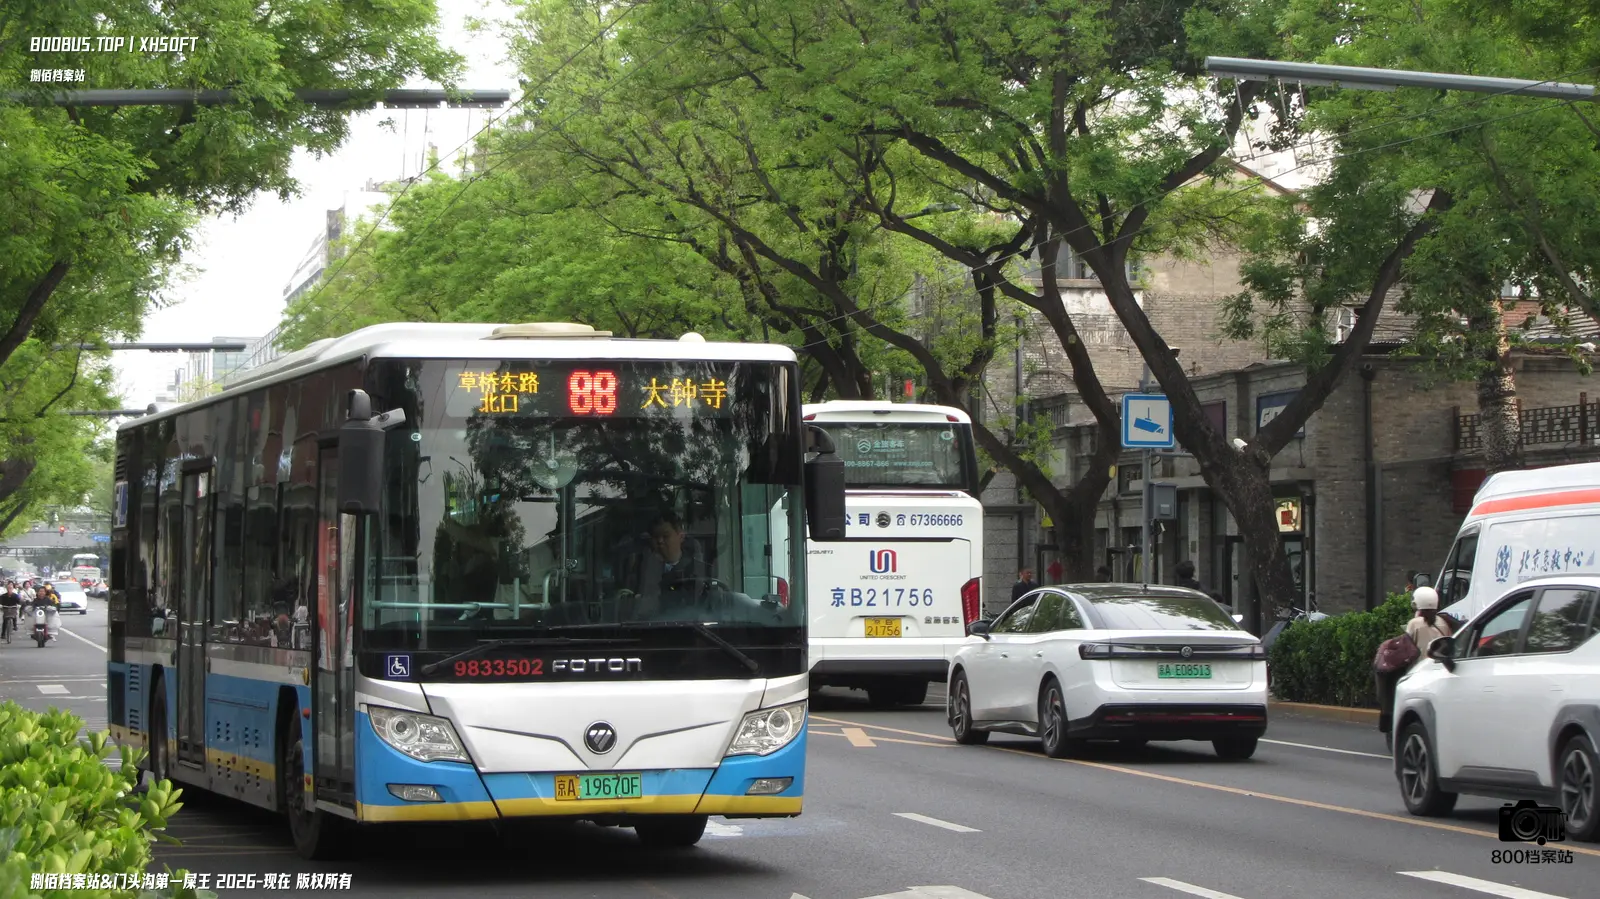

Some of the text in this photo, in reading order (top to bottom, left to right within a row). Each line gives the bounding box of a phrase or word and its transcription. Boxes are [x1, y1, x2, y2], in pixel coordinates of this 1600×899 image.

[458, 372, 540, 393] 草桥东路
[569, 371, 617, 413] 88
[479, 394, 519, 413] 北口
[641, 378, 729, 409] 大钟寺
[910, 514, 963, 526] 67366666
[1518, 547, 1583, 574] 北京急救中心
[831, 587, 933, 608] 京B21756
[867, 626, 900, 636] 21756
[455, 659, 544, 676] 9833502
[552, 657, 642, 673] FOTON
[584, 776, 640, 796] 19670F
